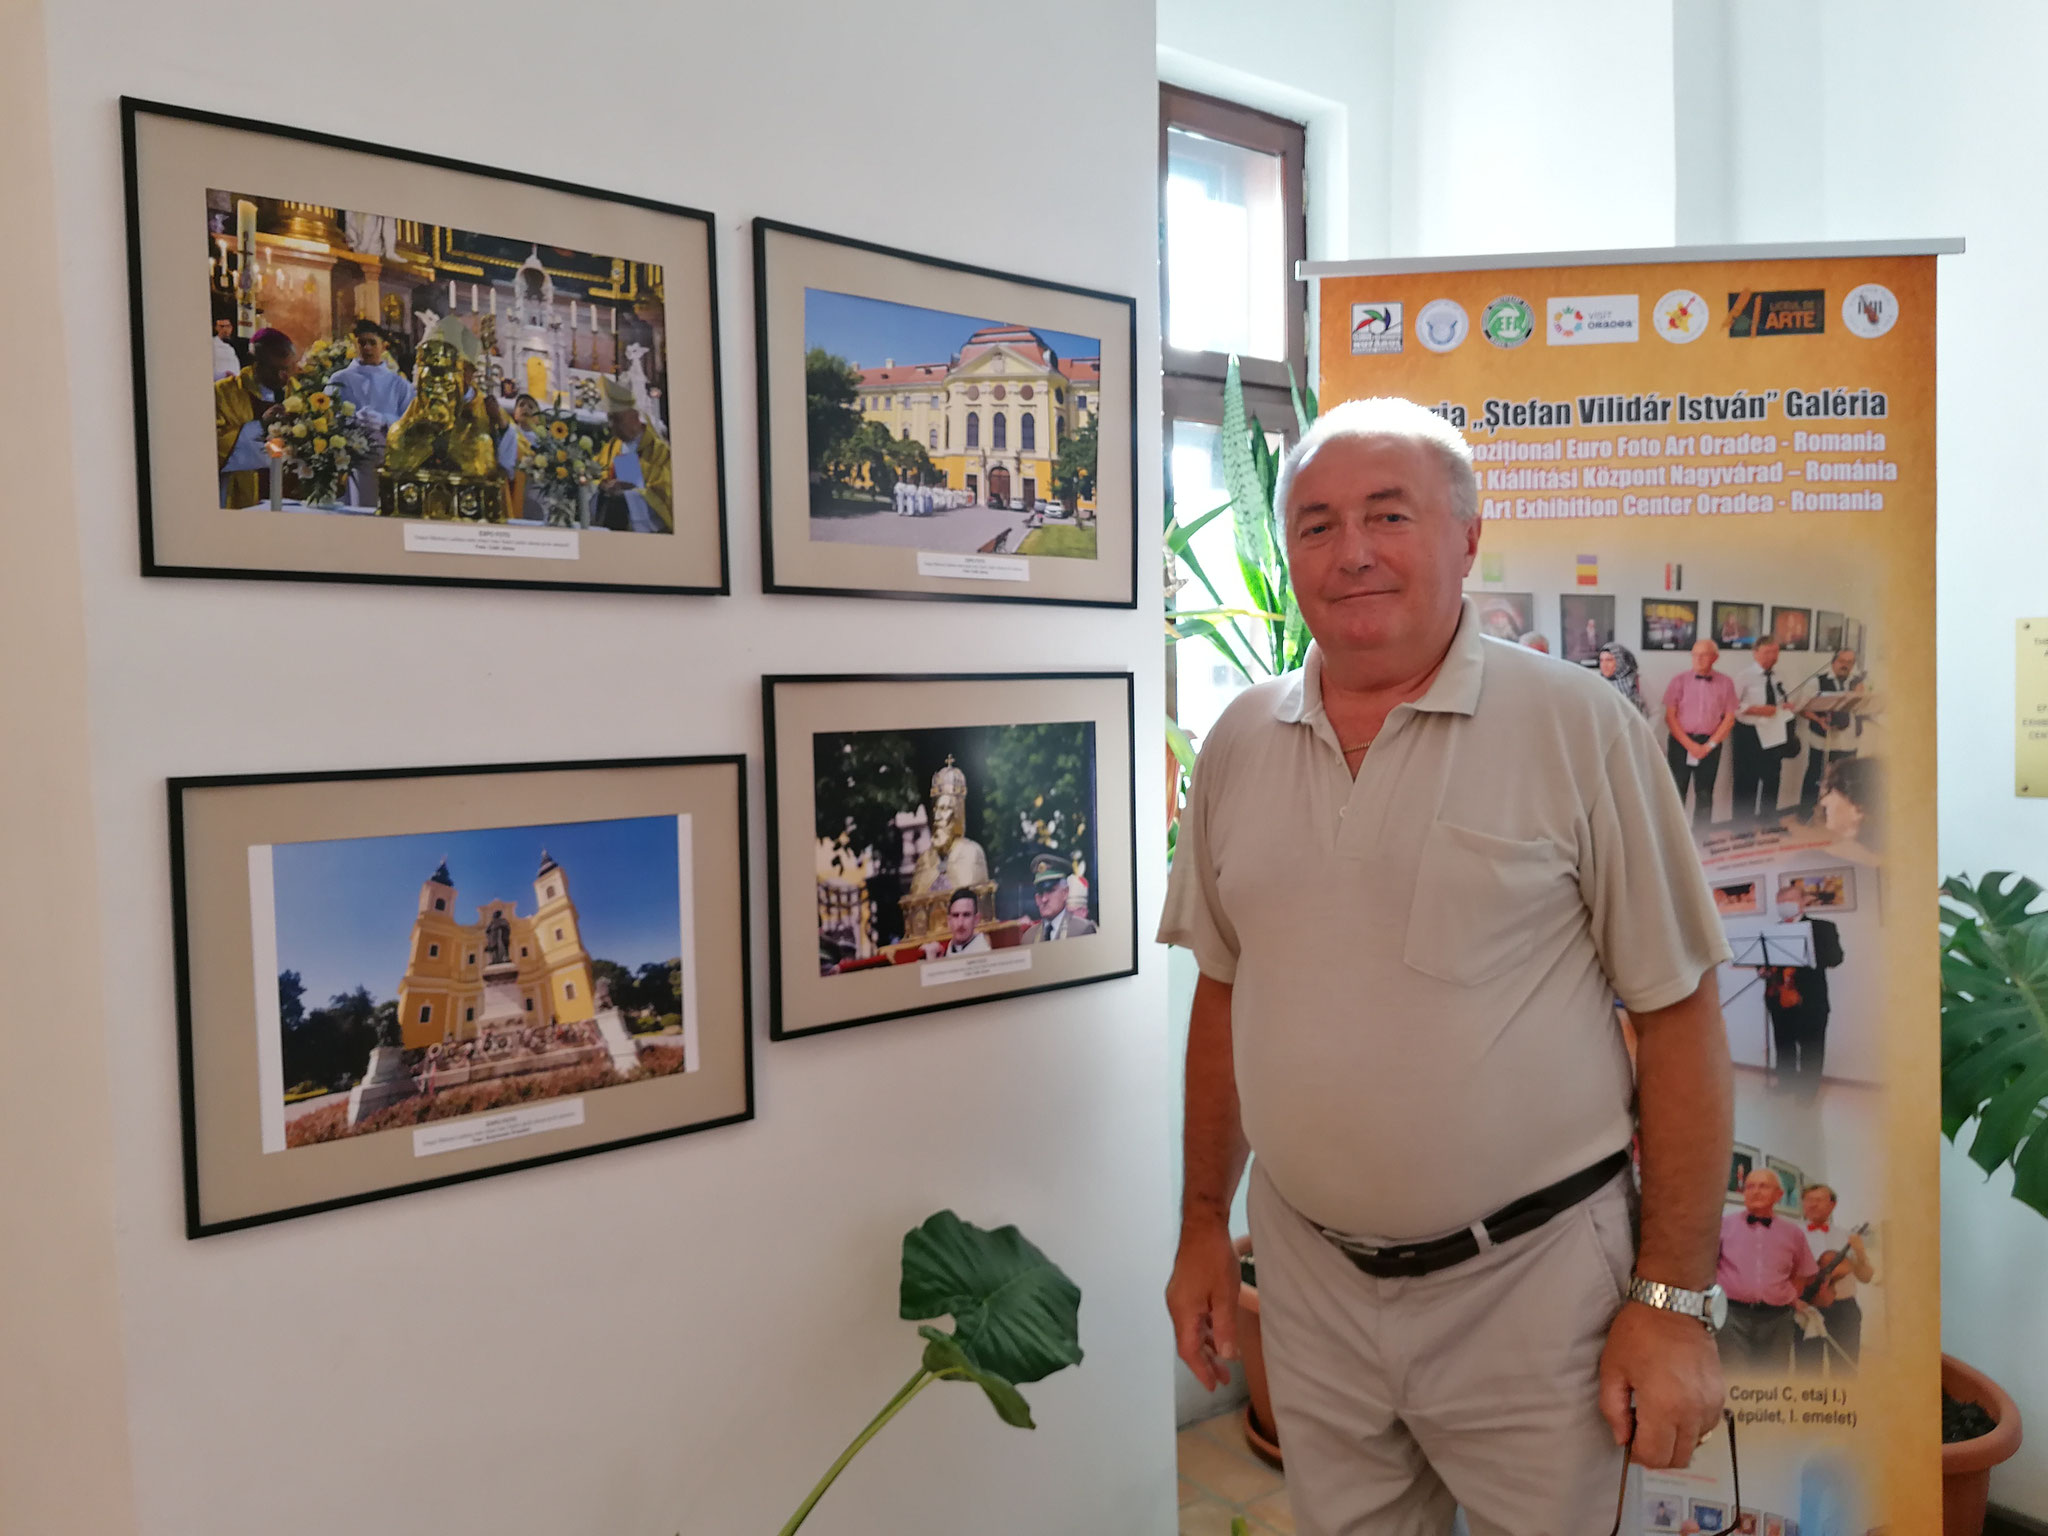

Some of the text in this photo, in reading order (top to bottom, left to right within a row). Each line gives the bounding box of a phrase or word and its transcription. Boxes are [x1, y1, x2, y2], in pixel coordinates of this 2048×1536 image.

[1765, 311, 1816, 329] ARTE
[1577, 393, 1671, 425] Vilidár
[1678, 389, 1778, 421] István”
[1786, 387, 1886, 418] Galéria
[1566, 437, 1614, 460] Euro
[1617, 436, 1661, 459] Foto
[1664, 435, 1696, 456] Art
[1699, 432, 1777, 456] Oradea
[1793, 430, 1887, 452] Romania
[1486, 464, 1579, 490] Kiállítási
[1582, 464, 1667, 490] Központ
[1669, 461, 1784, 488] Nagyvárad
[1804, 458, 1898, 482] Románia
[1481, 498, 1513, 520] Art
[1515, 496, 1619, 519] Exhibition
[1622, 494, 1693, 517] Center
[1696, 491, 1775, 515] Oradea
[1790, 489, 1884, 512] Romania
[1729, 1385, 1778, 1403] Corpul
[1801, 1387, 1828, 1405] etaj
[1802, 1409, 1858, 1428] emelet)
